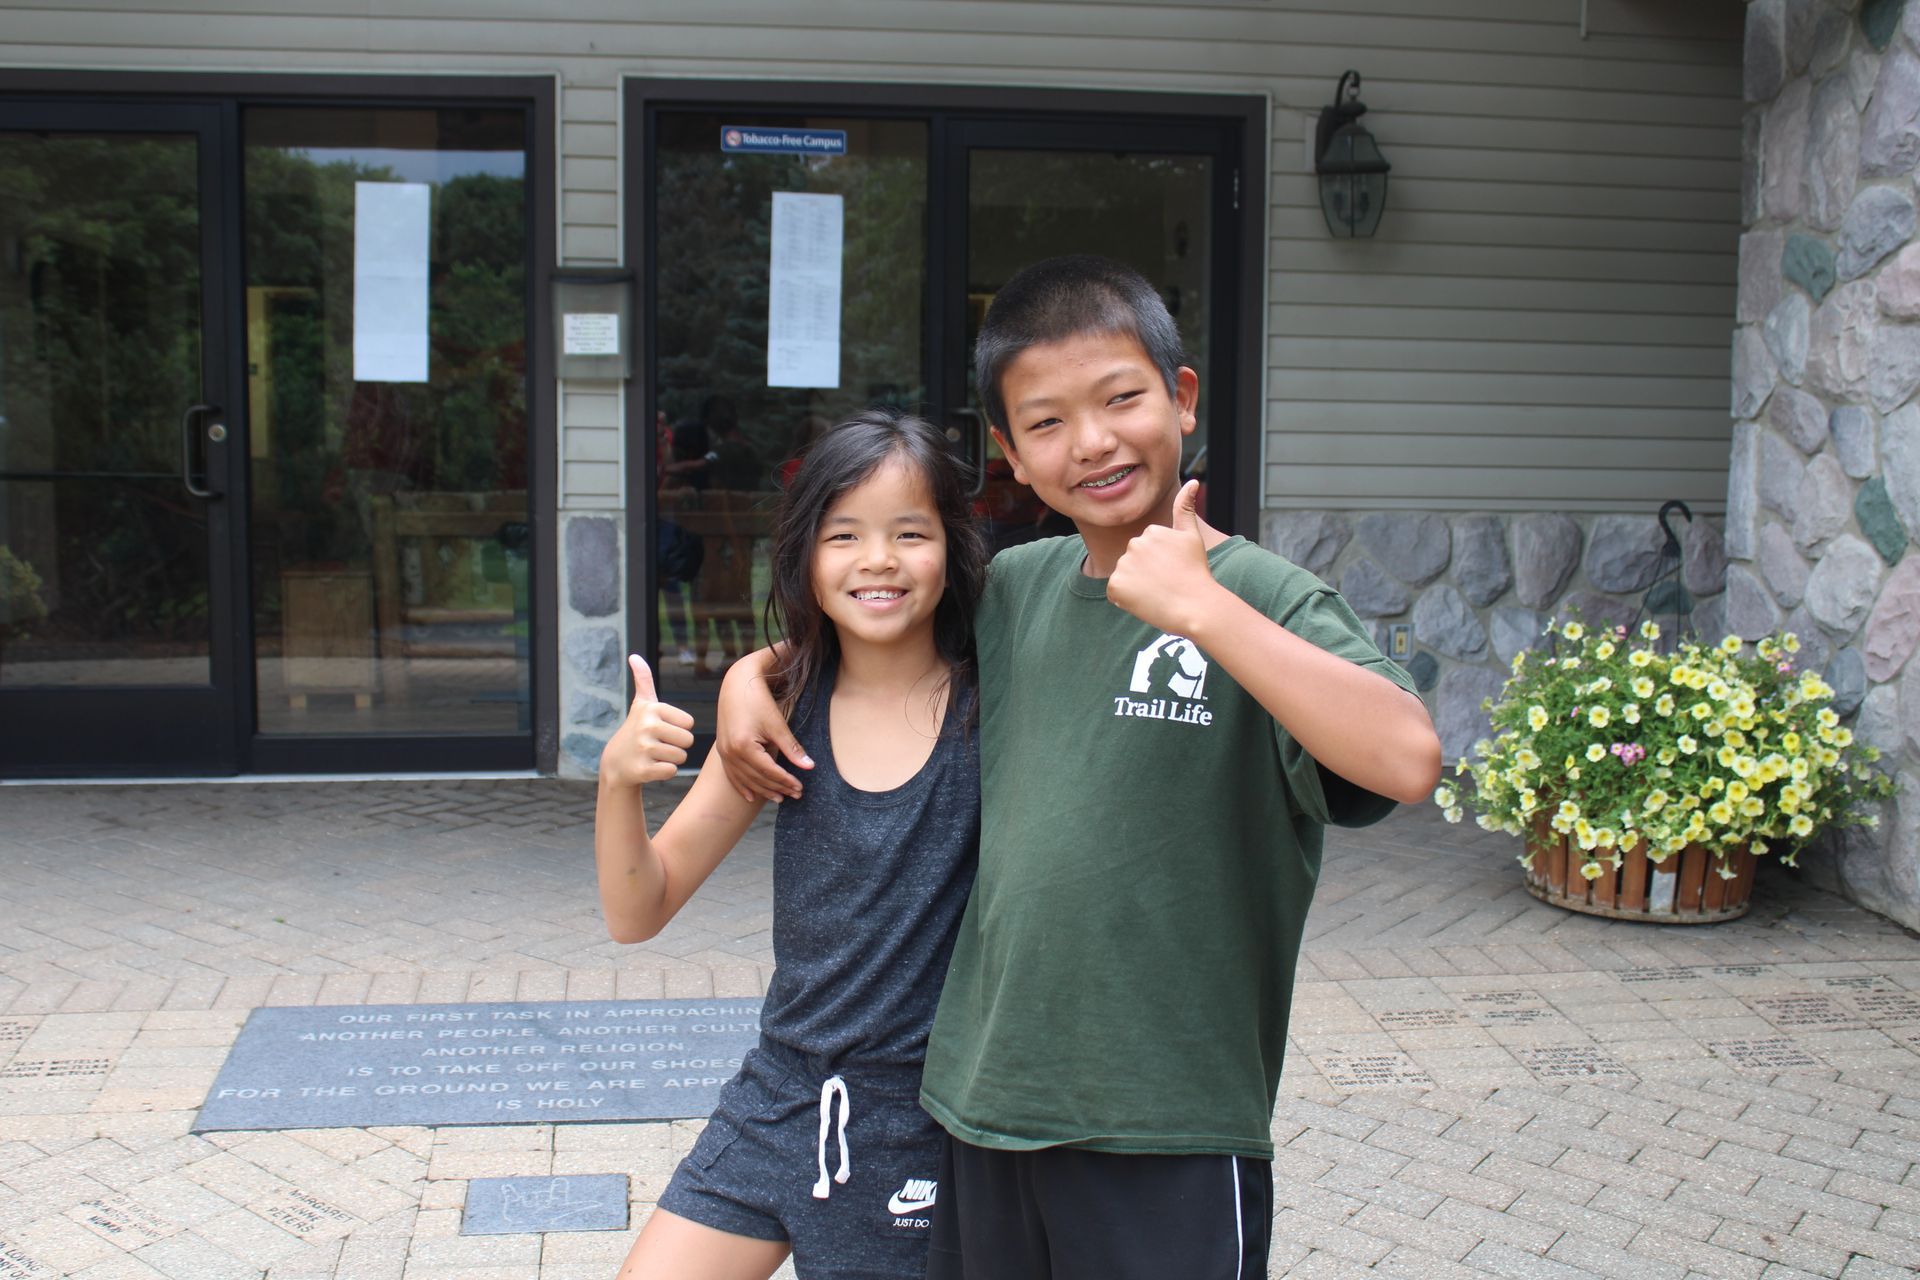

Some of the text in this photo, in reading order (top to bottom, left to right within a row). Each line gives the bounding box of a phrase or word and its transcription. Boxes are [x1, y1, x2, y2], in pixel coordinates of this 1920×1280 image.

[742, 133, 842, 149] Tobacco-Free Campus
[1114, 697, 1213, 726] Trail Life
[338, 1007, 762, 1024] OUR FIRST TASK IN APPROACHIN
[303, 1030, 424, 1041] ANOTHER
[558, 1025, 677, 1036] ANOTHER
[421, 1045, 545, 1057] ANOTHER
[347, 1065, 374, 1077] IS
[391, 1065, 421, 1075] TO
[435, 1064, 500, 1075] TAKE
[515, 1062, 566, 1073] OFF
[579, 1061, 637, 1072] OUR
[217, 1088, 281, 1099] FOR
[300, 1086, 357, 1097] THE
[375, 1082, 510, 1096] GROUND
[527, 1081, 570, 1092] WE
[587, 1079, 647, 1090] ARE
[497, 1098, 606, 1110] IS HOLY
[286, 1204, 325, 1223] ANNE
[288, 1189, 353, 1224] MARGARET
[266, 1207, 315, 1233] PETERS
[893, 1218, 930, 1228] JUST DO
[4, 1249, 45, 1272] LOVING
